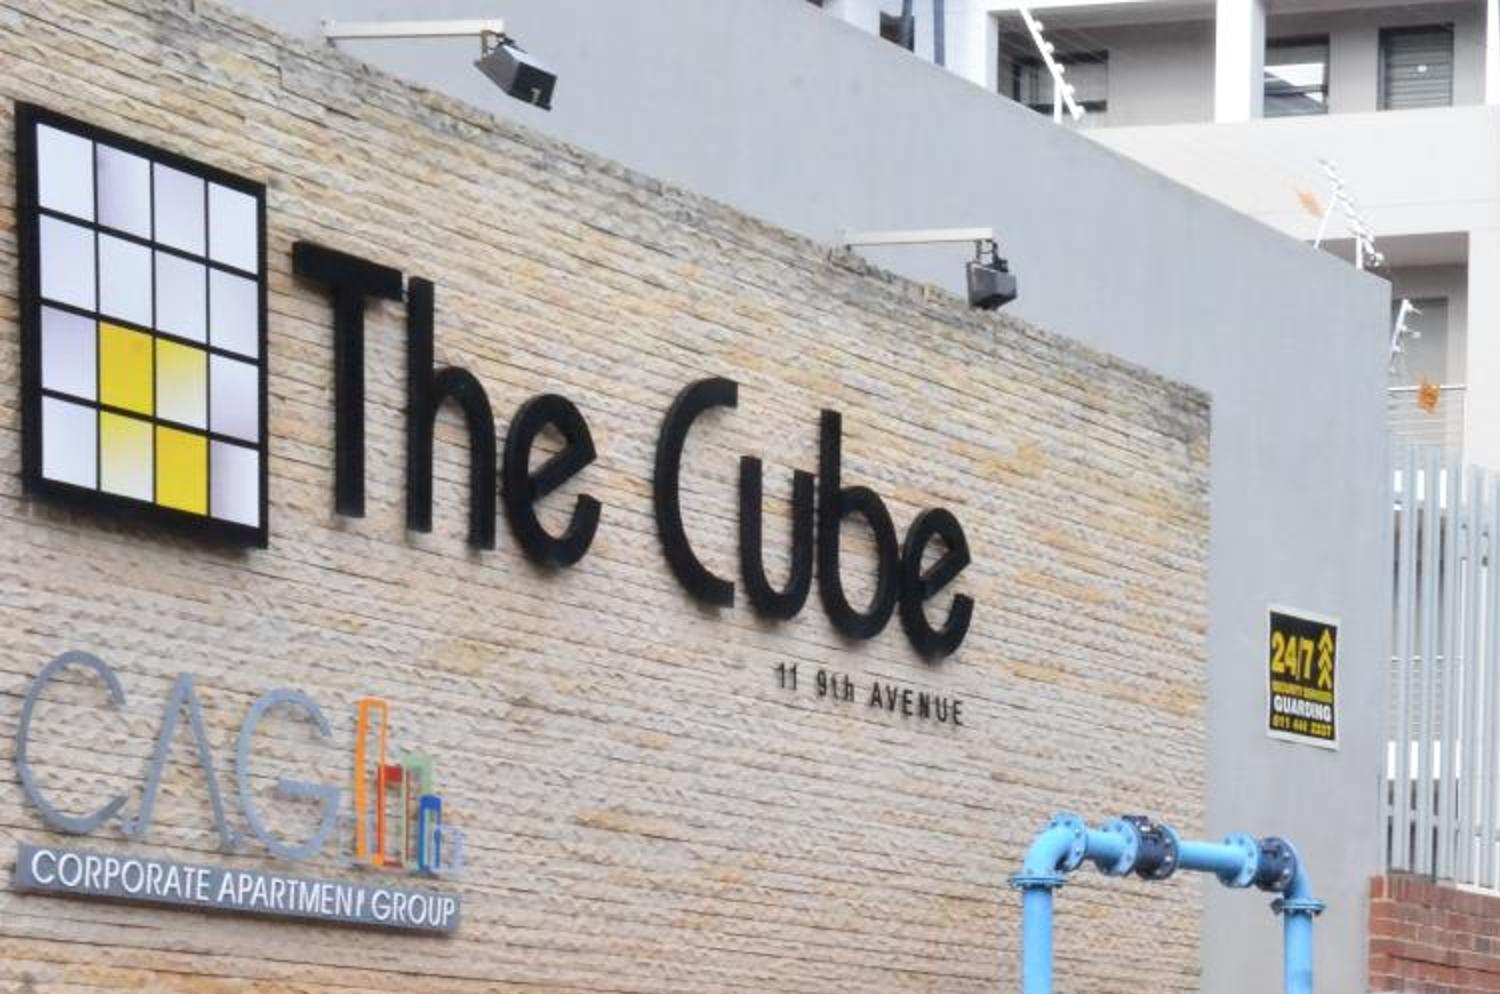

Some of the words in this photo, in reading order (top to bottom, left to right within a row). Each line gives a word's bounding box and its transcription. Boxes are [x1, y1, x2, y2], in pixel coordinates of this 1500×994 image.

[292, 240, 602, 570] The
[653, 375, 975, 661] Cube
[1271, 629, 1315, 681] 24/7
[775, 661, 798, 691] 11
[816, 669, 855, 703] 9th
[870, 681, 964, 726] AVENUE
[1273, 694, 1332, 723] GUARDING
[15, 649, 341, 861] CAG
[31, 849, 210, 901] CORPORATE
[371, 889, 456, 928] GROUP
